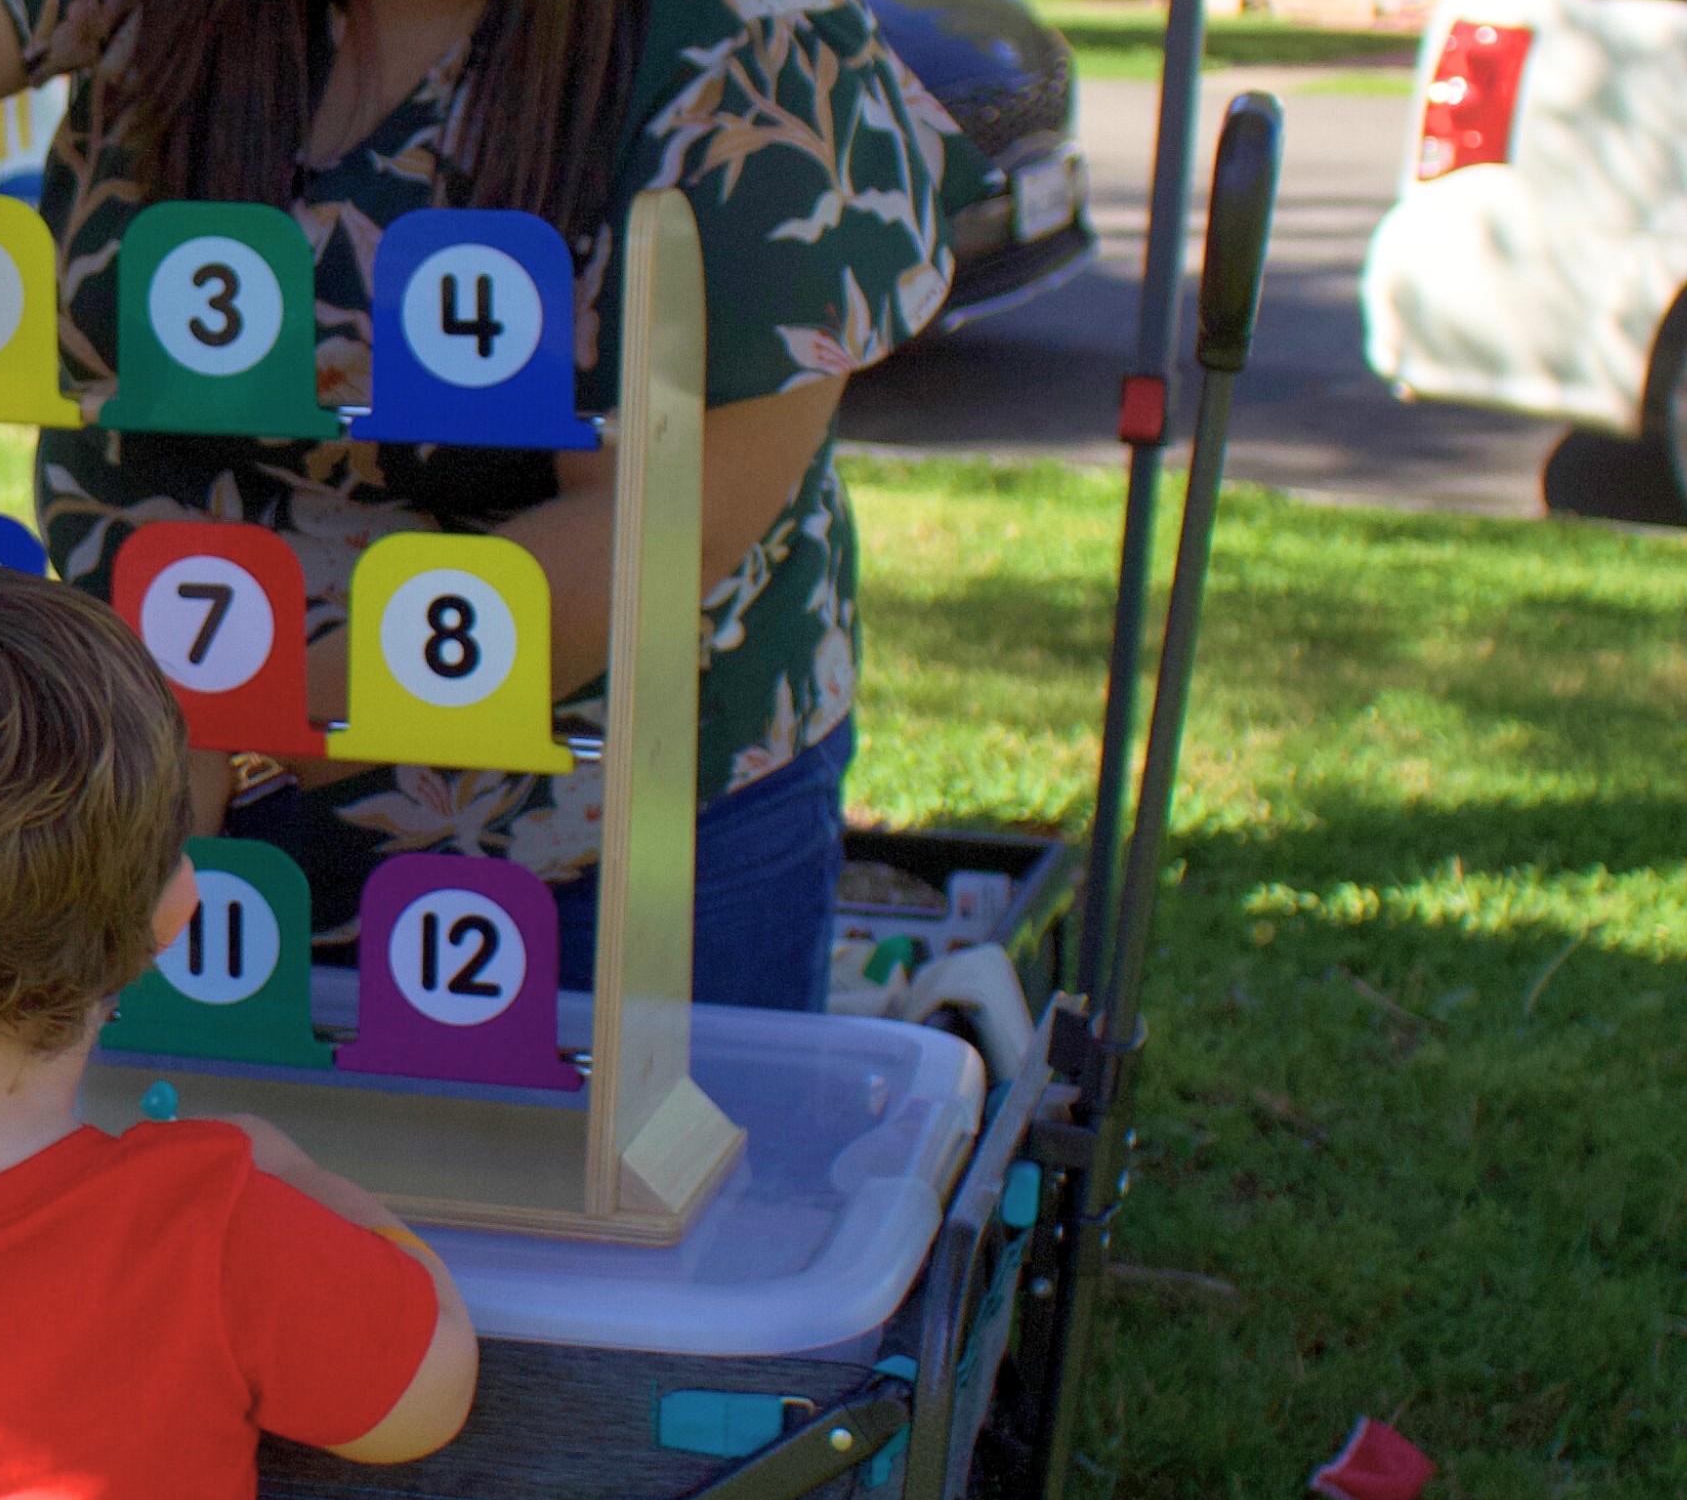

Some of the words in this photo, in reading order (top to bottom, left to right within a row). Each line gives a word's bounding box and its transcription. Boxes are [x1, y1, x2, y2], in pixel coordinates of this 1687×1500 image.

[189, 263, 243, 347] 3
[442, 274, 504, 358] 4
[178, 583, 233, 665] 7
[425, 595, 480, 679] 8
[188, 901, 243, 978] 11
[422, 913, 501, 997] 12
